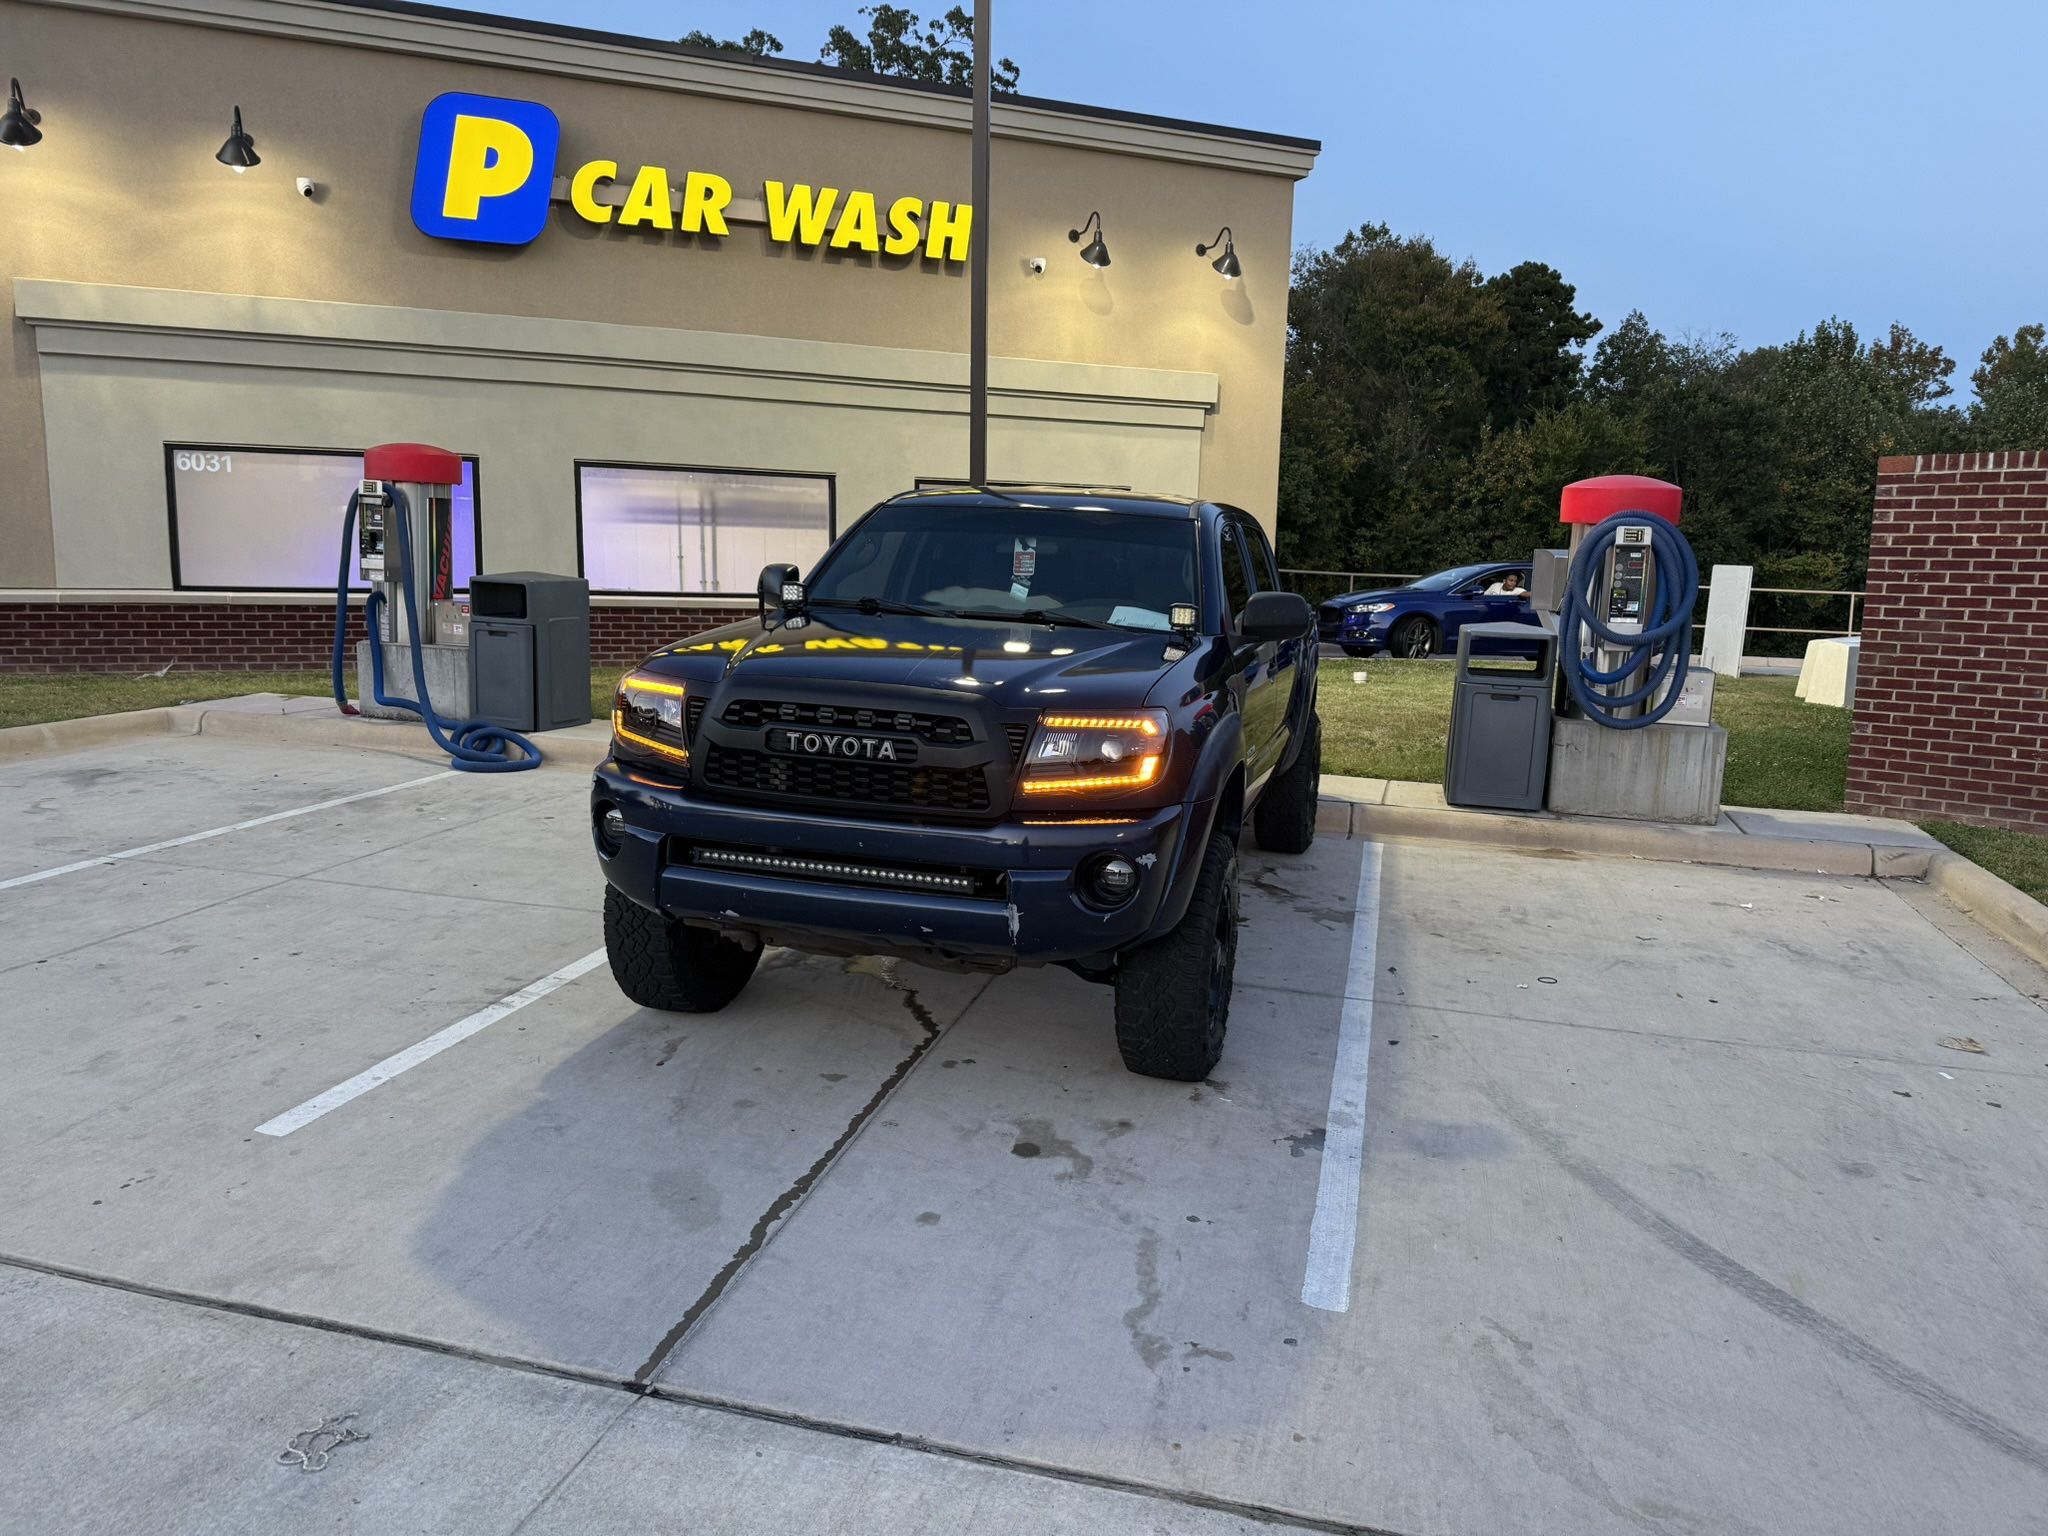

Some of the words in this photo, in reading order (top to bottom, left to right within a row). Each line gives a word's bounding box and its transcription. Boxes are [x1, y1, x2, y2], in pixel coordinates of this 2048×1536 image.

[442, 113, 534, 220] P
[570, 159, 733, 236] CAR
[764, 180, 972, 261] WASH
[176, 452, 232, 473] 6031
[786, 731, 897, 761] TOYOTA
